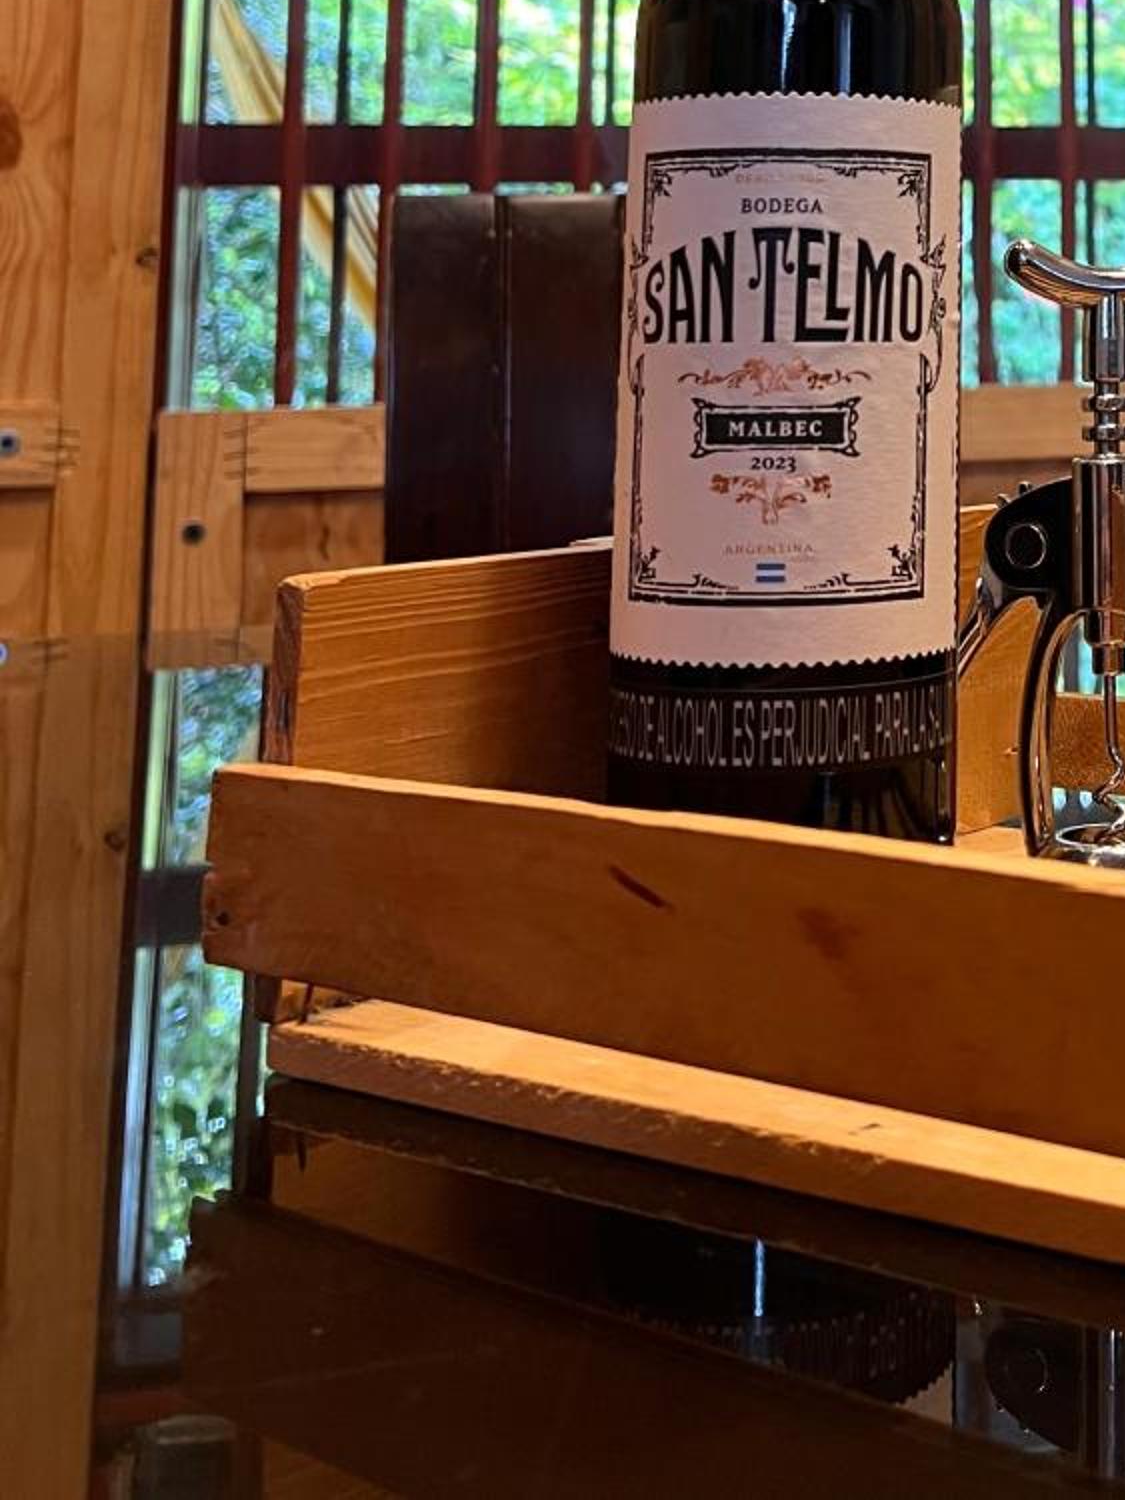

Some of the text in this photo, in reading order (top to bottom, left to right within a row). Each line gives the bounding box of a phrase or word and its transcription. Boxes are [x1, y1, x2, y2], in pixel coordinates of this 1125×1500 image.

[740, 197, 824, 215] BODEGA
[642, 225, 924, 345] SAN TELMO
[728, 418, 824, 439] MALBEC
[750, 455, 799, 475] 2023
[724, 542, 816, 557] ARGENTINA
[655, 695, 728, 768] ALCOHOL
[732, 698, 756, 768] ES
[760, 692, 872, 768] PERJUDICIAL
[873, 690, 911, 760] PARA
